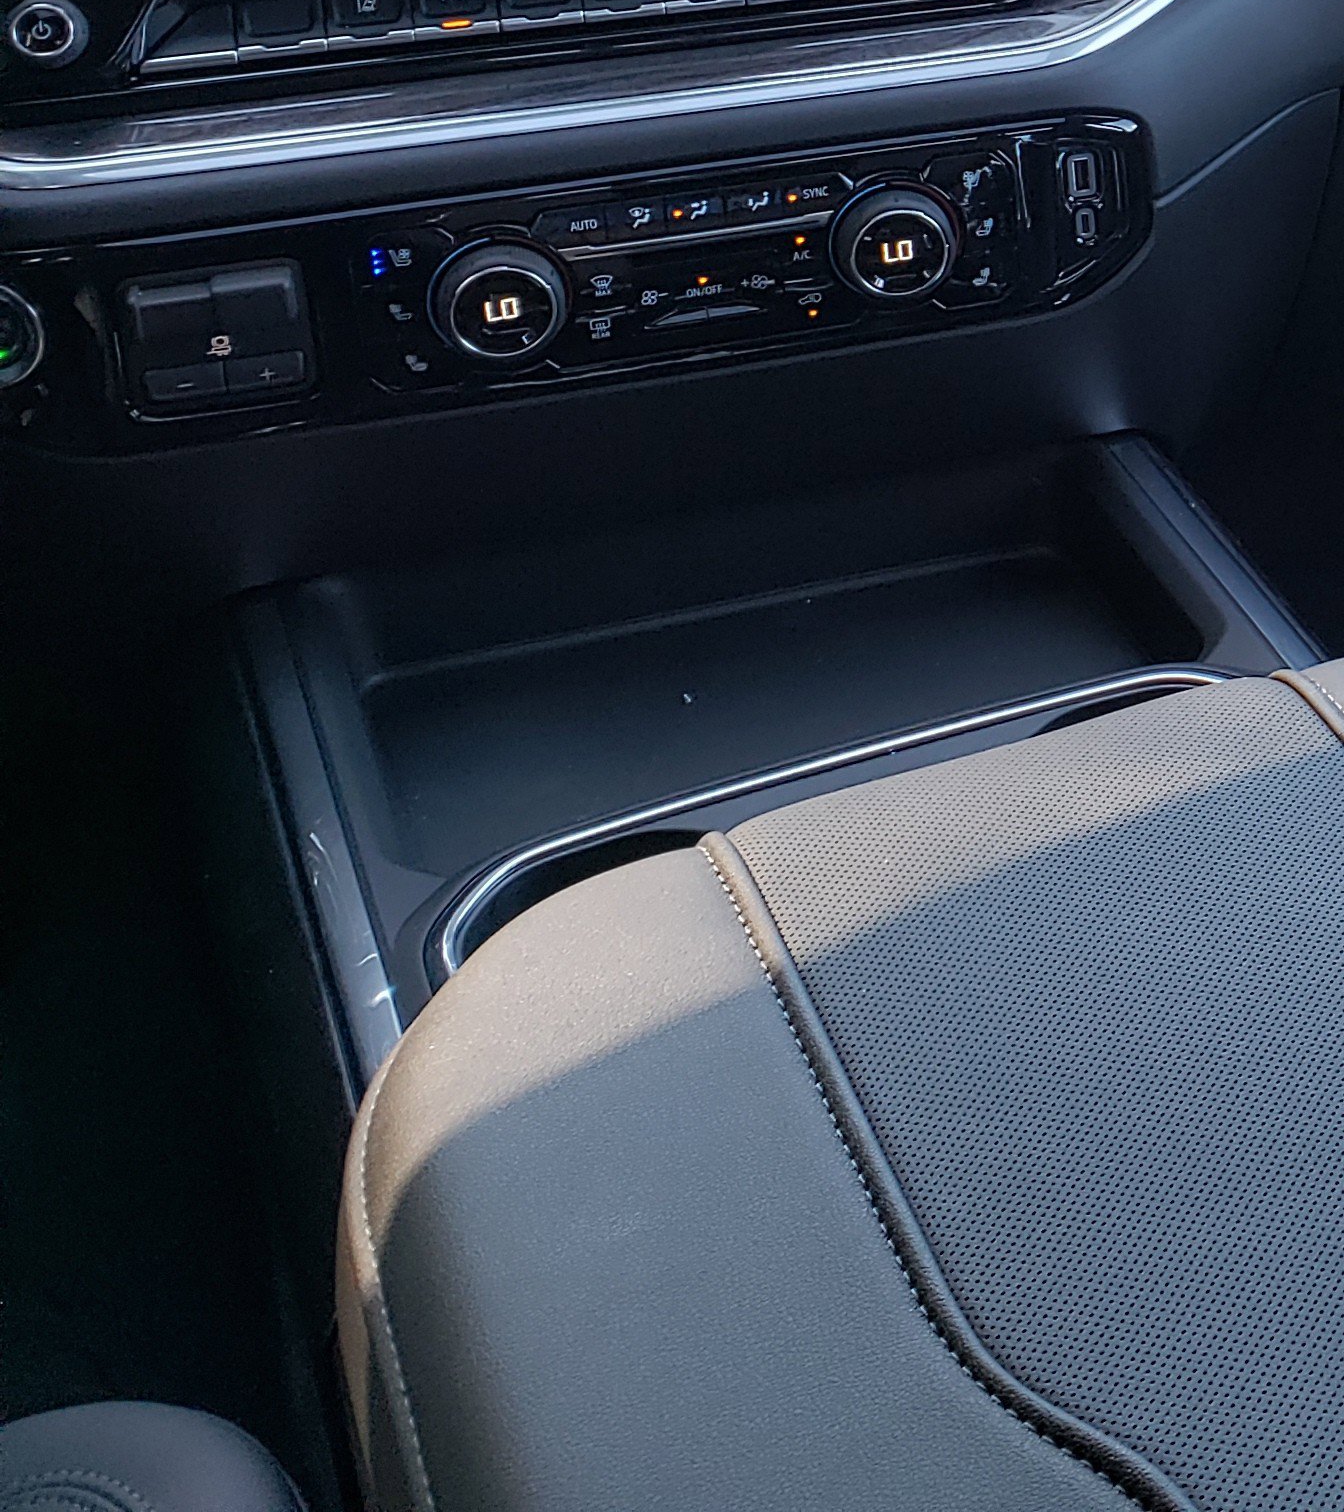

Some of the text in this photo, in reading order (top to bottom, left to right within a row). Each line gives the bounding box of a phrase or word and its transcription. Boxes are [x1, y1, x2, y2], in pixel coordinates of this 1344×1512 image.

[802, 186, 829, 199] SYNC
[570, 219, 598, 232] AUTO
[793, 250, 812, 261] A/C
[882, 239, 914, 264] LO
[686, 284, 723, 297] ON/OFF
[485, 296, 519, 323] LO
